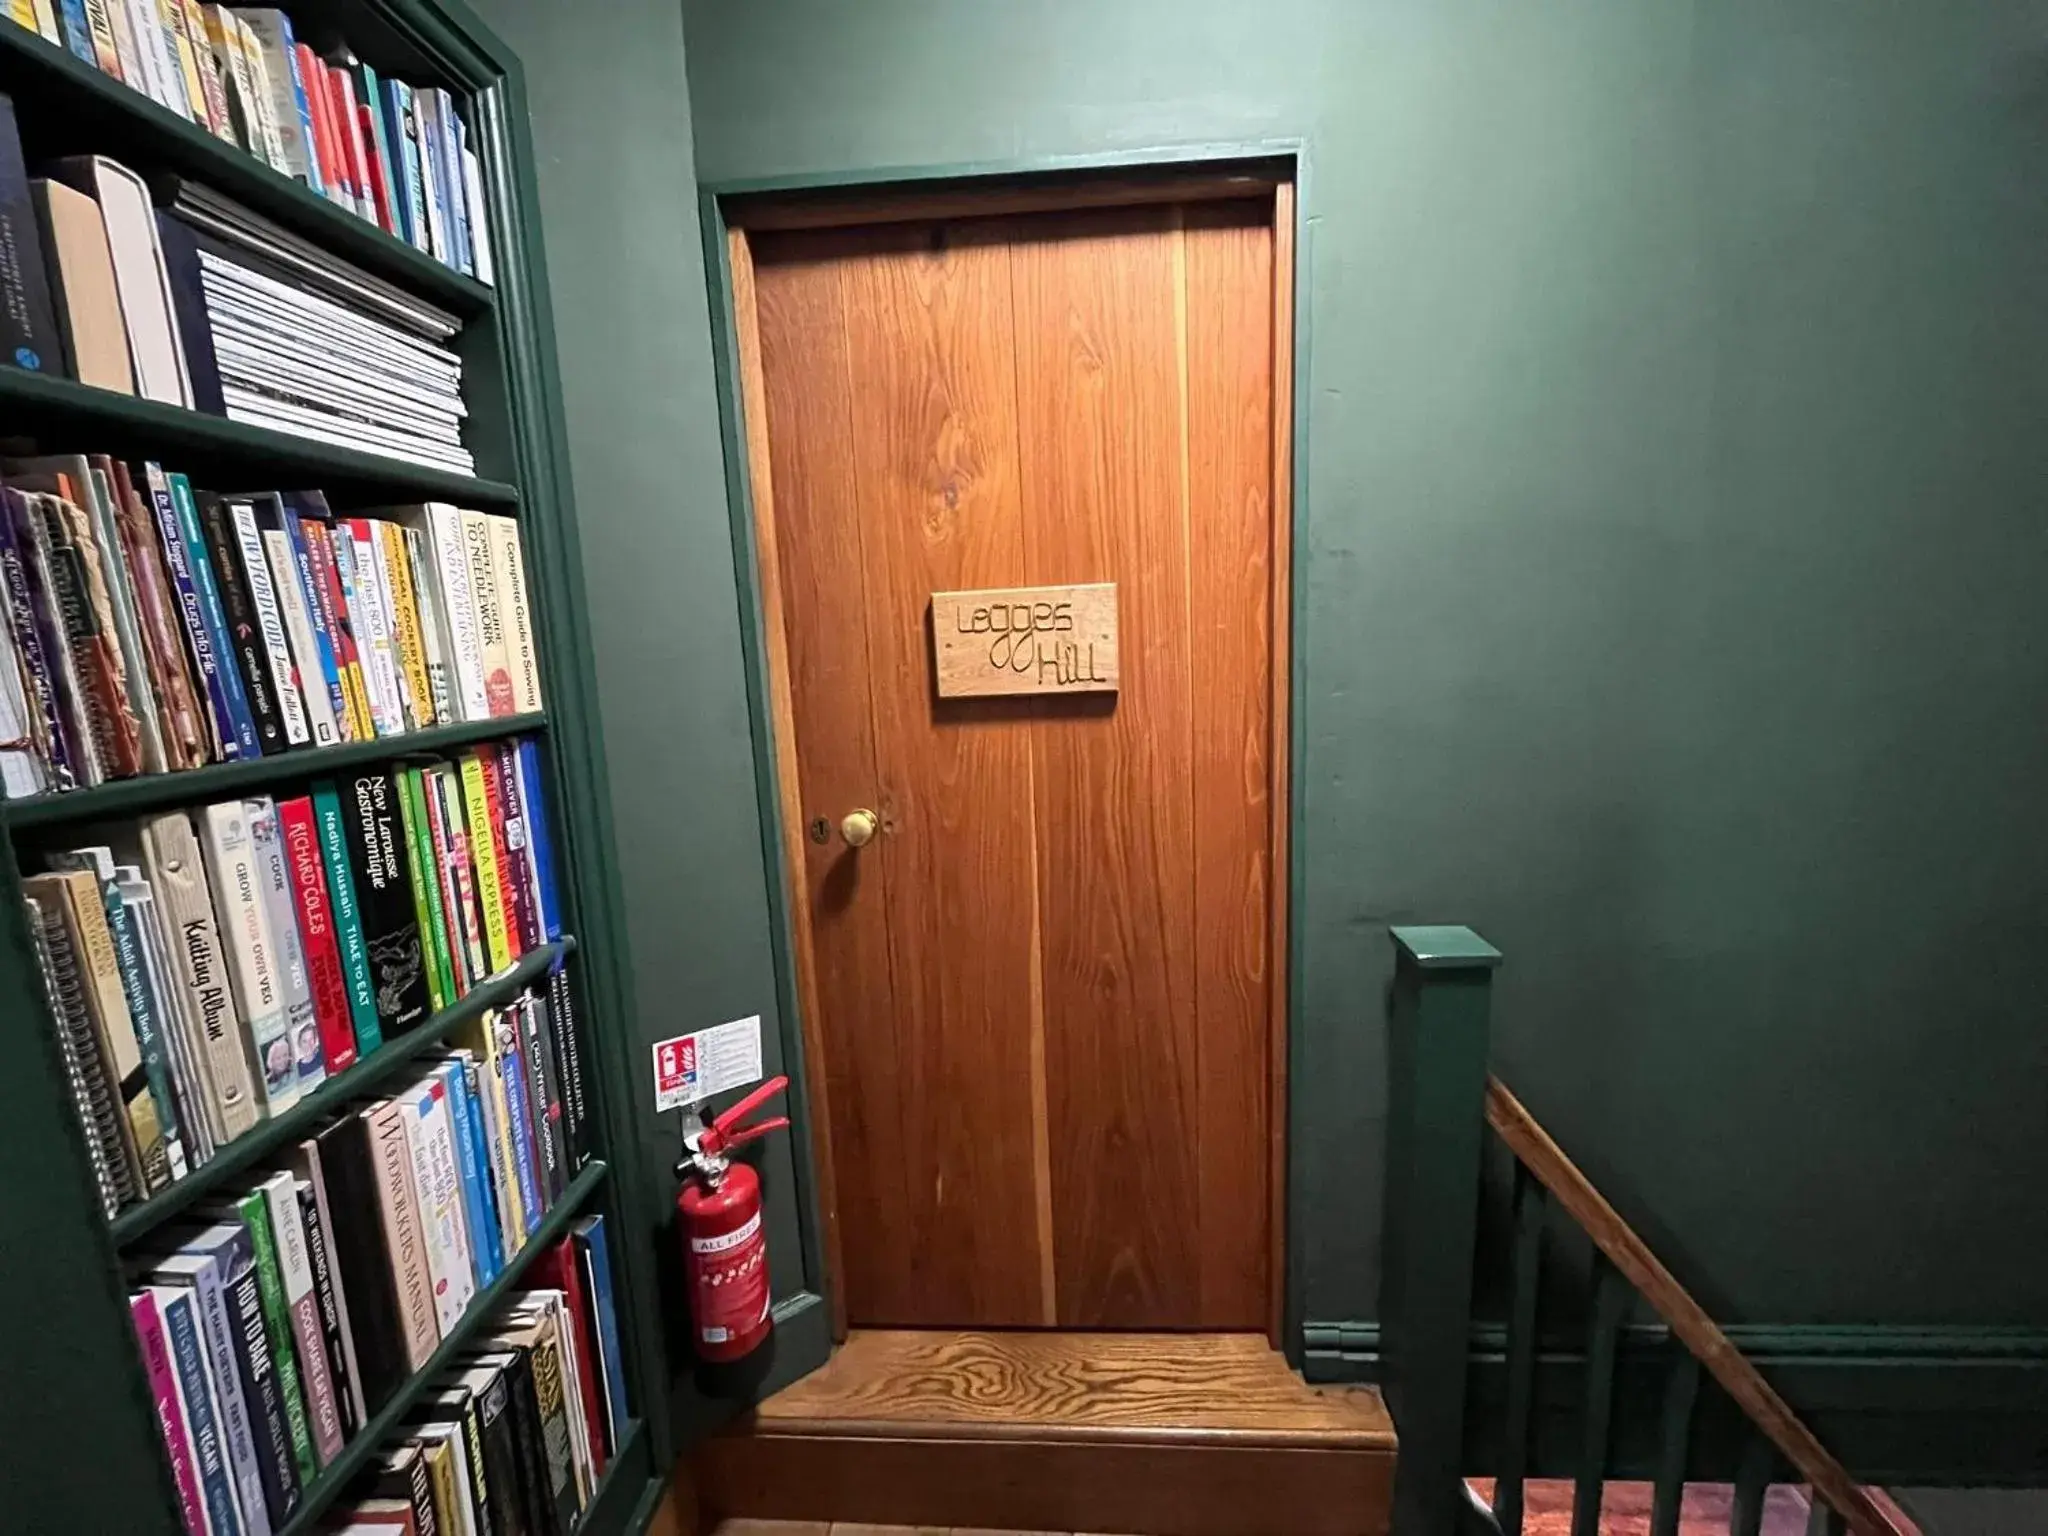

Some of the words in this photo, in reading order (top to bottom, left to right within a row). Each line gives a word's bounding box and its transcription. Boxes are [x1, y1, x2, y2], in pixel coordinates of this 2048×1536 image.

[157, 494, 168, 506] Dr.
[161, 509, 176, 538] Miriam
[238, 511, 252, 527] THE
[466, 523, 478, 542] TO
[170, 540, 188, 578] Stoppard
[307, 526, 320, 560] NAPLES
[445, 540, 456, 566] AND
[242, 532, 273, 607] TWYFORD
[317, 572, 327, 589] THE
[358, 553, 371, 576] the
[477, 522, 494, 592] COMPLETE
[491, 602, 501, 640] GUIDE
[506, 541, 520, 603] Complete
[299, 553, 317, 606] Southern
[313, 608, 325, 633] Italy
[321, 591, 333, 622] AMALFI
[363, 579, 376, 605] fast
[471, 547, 493, 645] NEEDLEWORK
[181, 593, 200, 628] Drugs
[369, 609, 383, 636] 800
[389, 524, 407, 598] UNIVERSAL
[403, 606, 418, 664] COOKERY
[414, 669, 426, 702] BOOK
[449, 570, 470, 661] ENTERTAINING
[515, 605, 527, 642] Guide
[195, 630, 208, 652] Info
[262, 612, 284, 647] CODE
[329, 625, 341, 653] COAST
[957, 602, 1073, 673] Legges
[201, 653, 215, 674] File
[521, 645, 528, 658] to
[1037, 640, 1107, 685] Hill
[274, 655, 294, 685] Janice
[523, 660, 535, 706] Sewing
[253, 683, 269, 714] panjabi
[283, 688, 298, 720] Hallett
[371, 776, 386, 809] New
[505, 778, 517, 814] OLIVER
[356, 779, 384, 887] Gastronomique
[378, 817, 397, 877] Larousse
[289, 822, 315, 884] RICHARD
[303, 887, 324, 934] COLES
[325, 811, 340, 860] Nadiya
[335, 864, 351, 918] Hussain
[472, 797, 490, 866] NIGELLA
[483, 872, 501, 937] EXPRESS
[236, 862, 252, 902] GROW
[244, 905, 260, 941] YOUR
[252, 944, 267, 975] OWN
[260, 976, 272, 1005] VEG
[270, 854, 284, 891] COOK
[290, 962, 302, 989] VEG
[347, 924, 361, 961] TIME
[112, 906, 125, 930] The
[120, 934, 134, 965] Adult
[128, 968, 144, 1011] Activity
[138, 1013, 153, 1044] Book
[184, 919, 211, 987] Knitting
[200, 987, 225, 1040] Album
[354, 964, 363, 980] TO
[559, 969, 568, 996] DELIA
[356, 981, 369, 1005] EAT
[551, 977, 559, 1003] DELIA
[555, 1005, 563, 1039] SMITH'S
[563, 998, 573, 1032] SMITH'S
[568, 1033, 578, 1065] WINTER
[506, 1065, 515, 1089] THE
[573, 1067, 584, 1119] COLLECTION
[454, 1076, 465, 1118] Baking
[463, 1152, 473, 1179] Easy
[510, 1090, 522, 1141] COMPLETE
[537, 1071, 547, 1109] Winter
[542, 1113, 554, 1170] Cookbook
[415, 1146, 426, 1170] fast
[517, 1143, 525, 1161] AGA
[419, 1174, 431, 1198] diet
[521, 1163, 532, 1214] COOKBOOK
[308, 1208, 317, 1225] 101
[379, 1113, 415, 1263] WOODWORKERS
[408, 1265, 424, 1342] MANUAL
[311, 1227, 327, 1278] WEEKENDS
[700, 1240, 722, 1251] ALL
[728, 1222, 757, 1243] FIRES
[207, 1287, 218, 1313] THE
[237, 1278, 257, 1312] HOW
[321, 1279, 329, 1292] IN
[212, 1313, 224, 1346] HAIRY
[244, 1313, 263, 1339] TO
[300, 1300, 313, 1332] COOK
[322, 1293, 336, 1331] EUROPE
[218, 1348, 234, 1395] DIETERS
[249, 1337, 270, 1380] BAKE
[306, 1335, 321, 1374] SHARE
[281, 1361, 295, 1393] PHIL
[314, 1374, 326, 1396] EAT
[230, 1402, 242, 1430] FAST
[237, 1434, 248, 1462] FOOD
[287, 1395, 306, 1450] VICKERY
[319, 1395, 333, 1436] VEGAN
[261, 1379, 274, 1411] PAUL
[269, 1412, 290, 1488] HOLLYWOOD
[411, 1458, 427, 1502] THE
